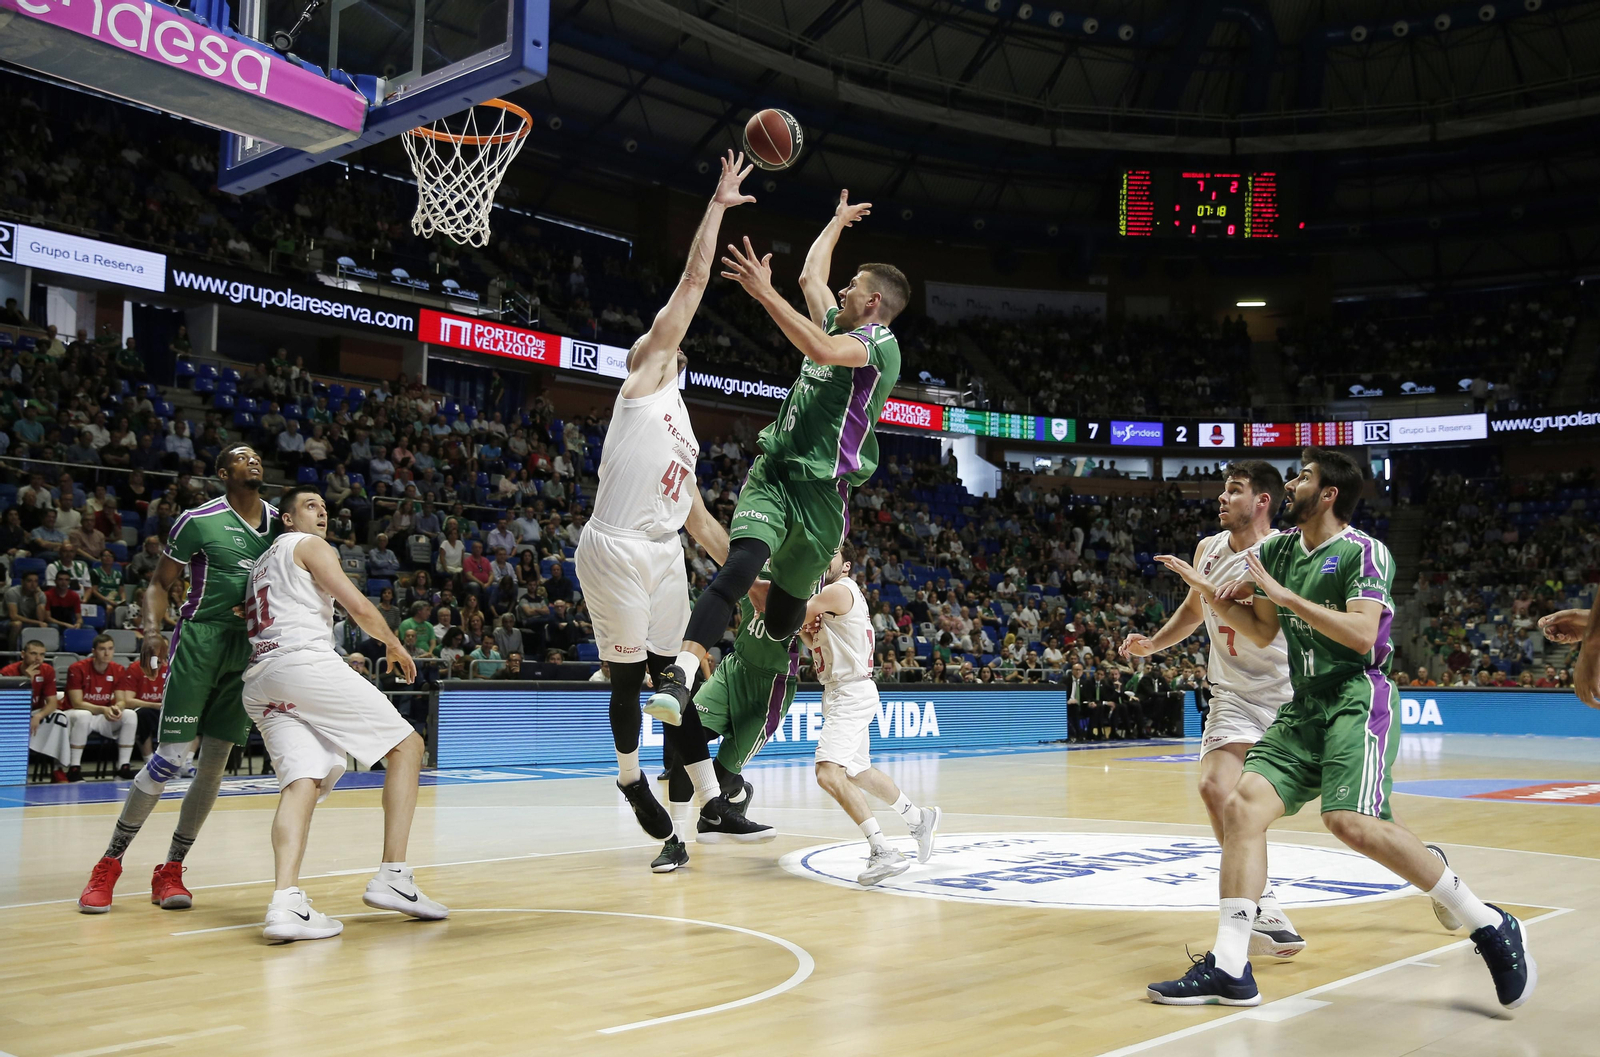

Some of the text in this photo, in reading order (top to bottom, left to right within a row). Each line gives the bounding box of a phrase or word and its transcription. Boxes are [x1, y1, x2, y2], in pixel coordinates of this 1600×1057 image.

[1197, 180, 1205, 192] 7
[1230, 181, 1239, 193] 2
[1197, 205, 1227, 217] 07:18
[1227, 224, 1236, 235] 0
[30, 242, 144, 274] Grupo La Reserva
[172, 269, 413, 332] www.grupolareserva.com
[474, 323, 536, 348] PORTICO
[474, 336, 546, 360] VELAZQUEZ
[606, 356, 629, 369] Grup
[1088, 423, 1099, 439] 7
[1176, 426, 1187, 442] 2
[1399, 423, 1472, 436] Grupo La Reserva
[660, 460, 690, 503] 41
[747, 620, 765, 639] 40
[1218, 625, 1238, 657] 7
[165, 715, 199, 724] worten
[873, 701, 941, 739] VIDA
[1400, 699, 1444, 726] DA
